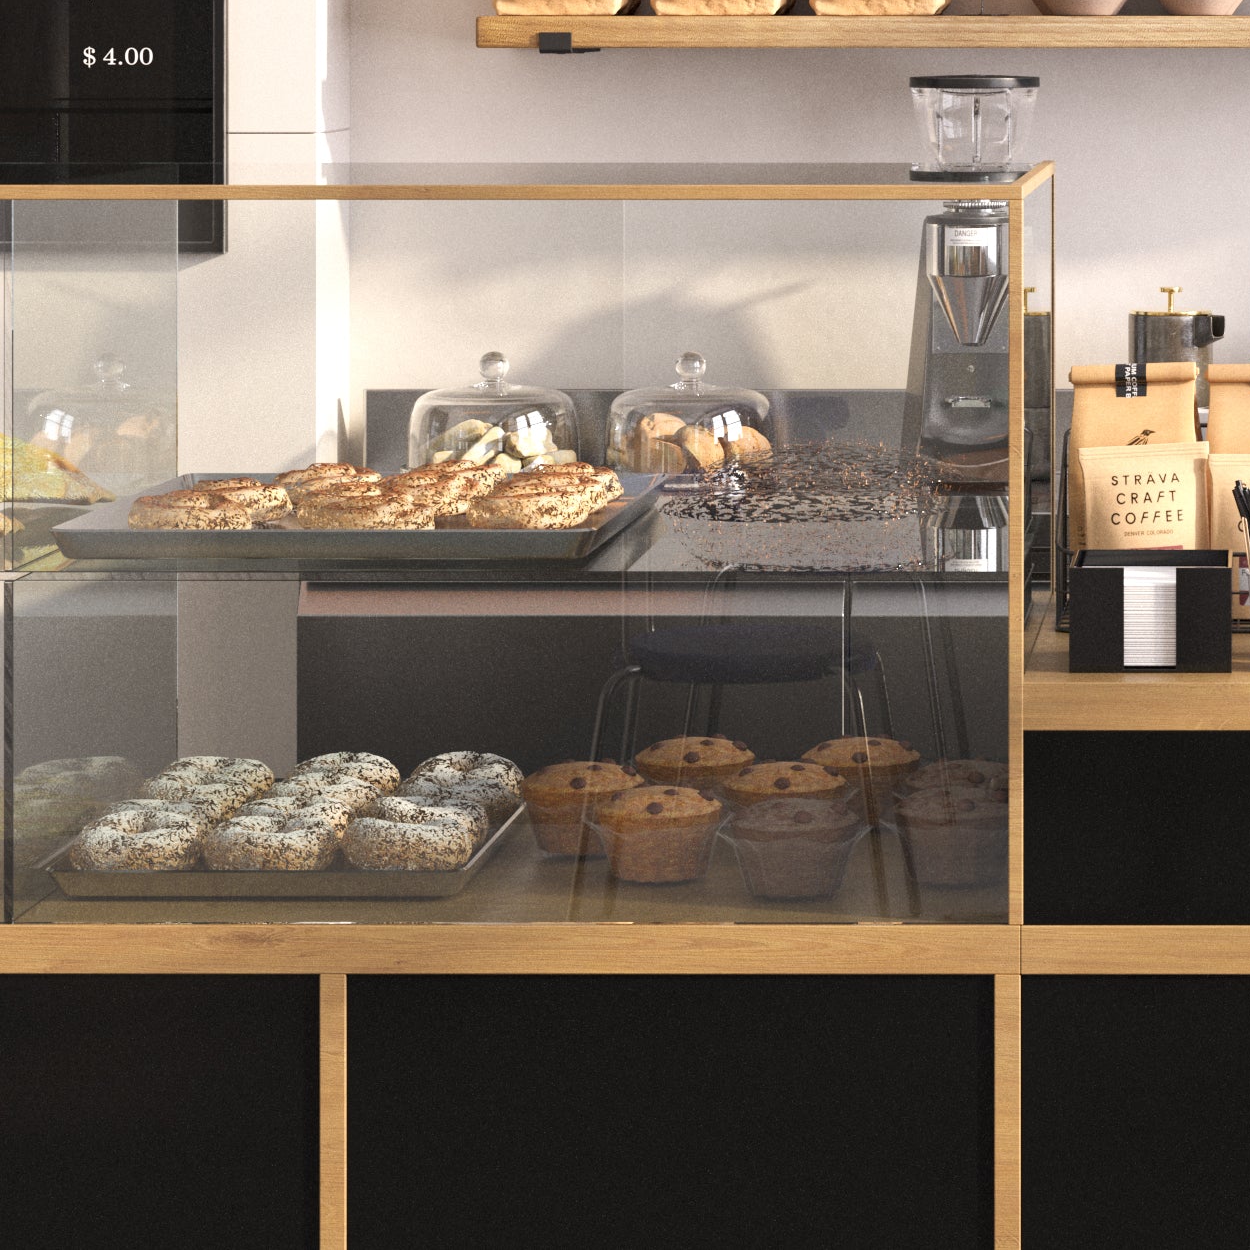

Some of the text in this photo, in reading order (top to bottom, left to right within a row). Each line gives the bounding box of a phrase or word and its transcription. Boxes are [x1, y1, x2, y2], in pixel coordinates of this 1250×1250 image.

[102, 46, 154, 66] 4.00
[1116, 490, 1176, 505] CRAFT
[1110, 509, 1184, 525] COFFEE
